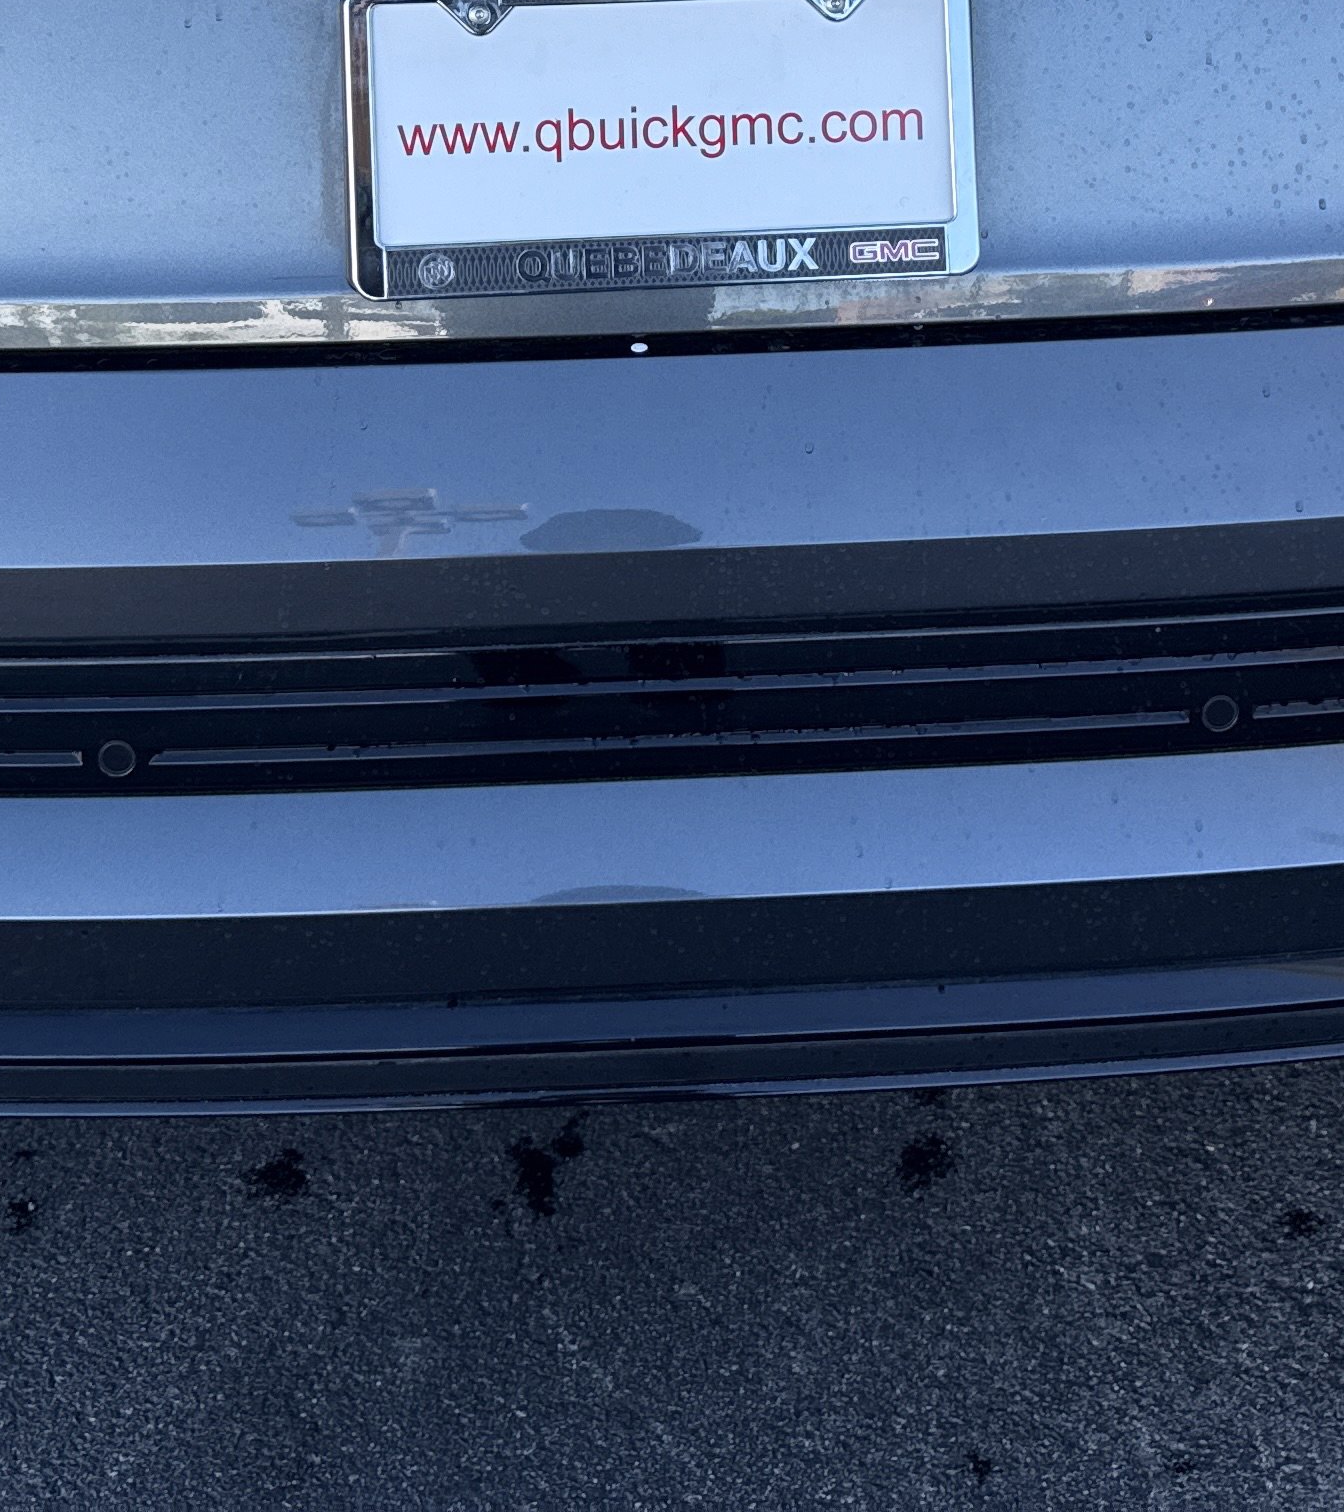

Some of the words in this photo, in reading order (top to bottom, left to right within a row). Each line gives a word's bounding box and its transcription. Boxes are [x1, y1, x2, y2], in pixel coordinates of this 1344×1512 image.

[396, 104, 924, 163] www.qbuickgmc.com
[515, 238, 820, 284] QUEBEDEAUX
[849, 238, 941, 265] GMC
